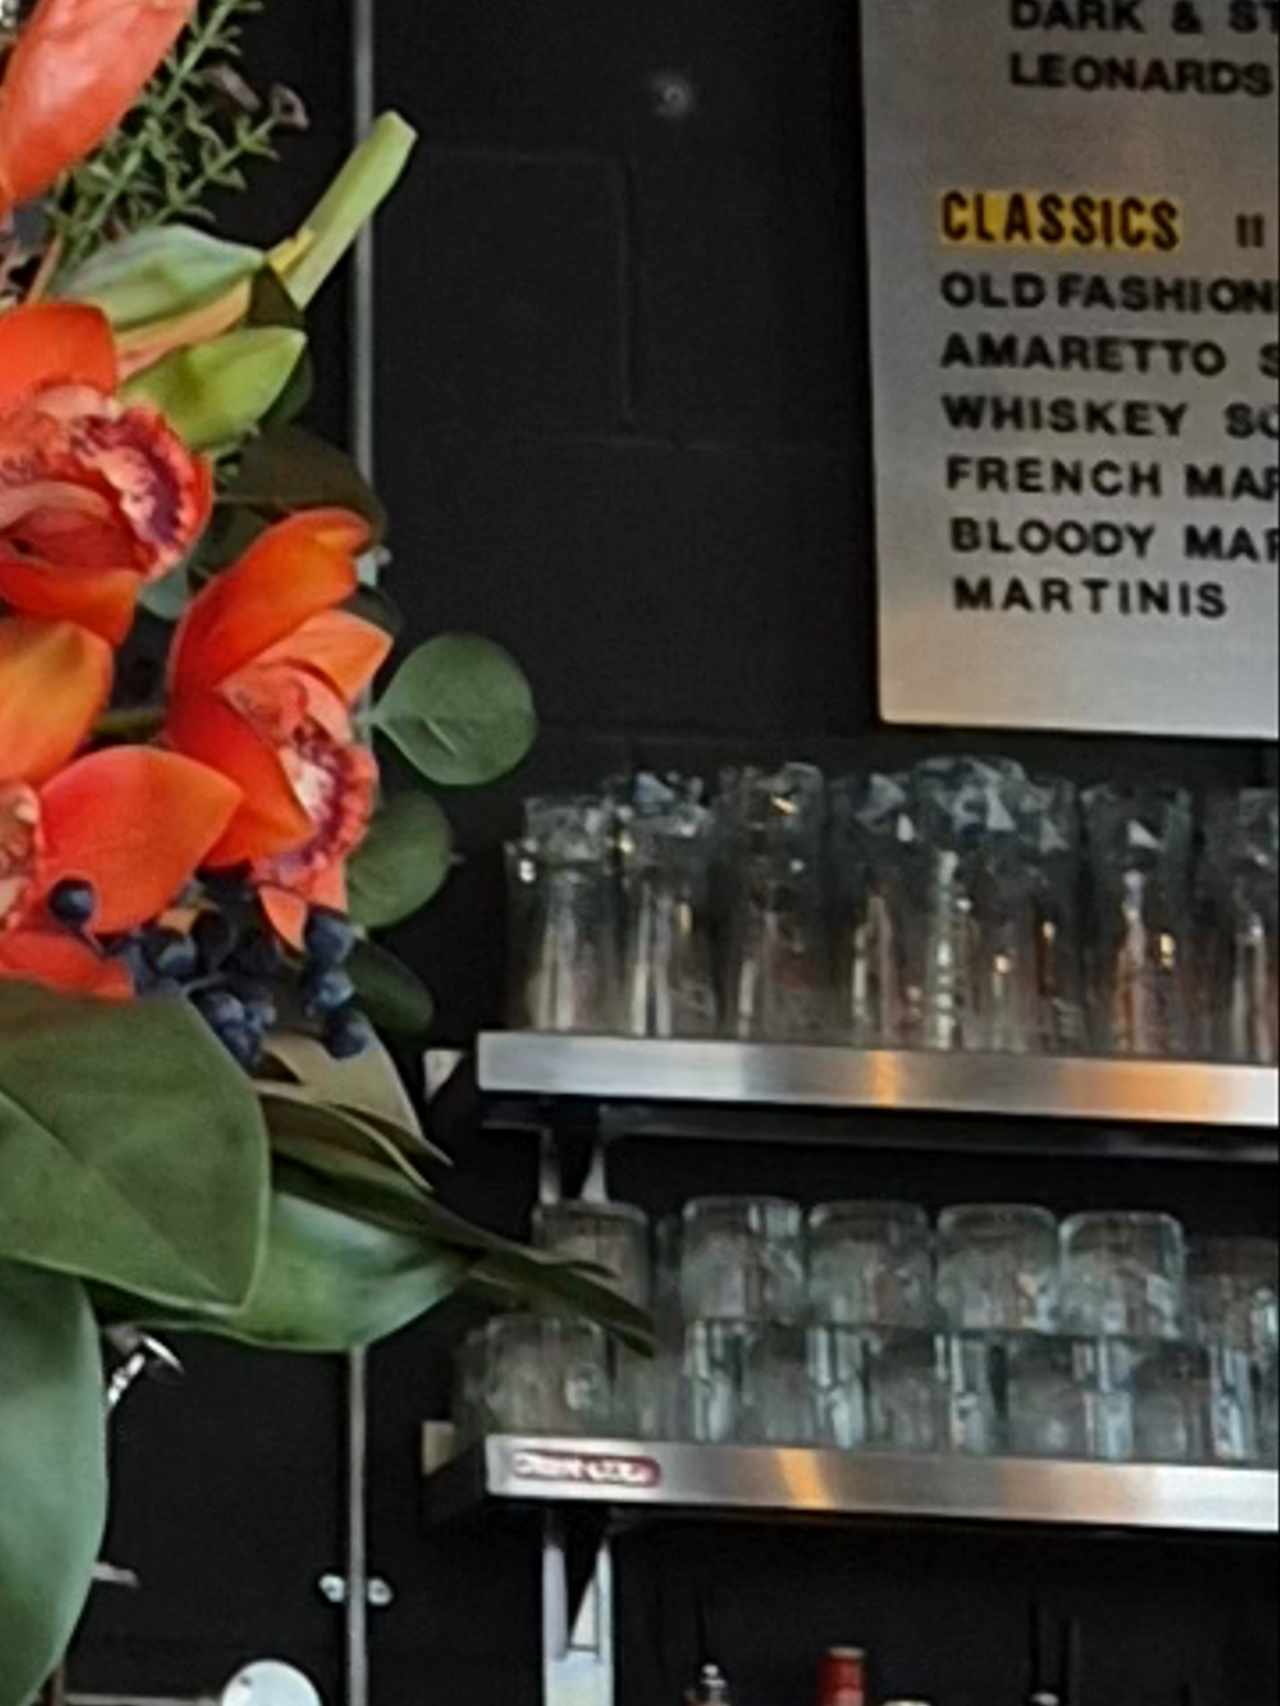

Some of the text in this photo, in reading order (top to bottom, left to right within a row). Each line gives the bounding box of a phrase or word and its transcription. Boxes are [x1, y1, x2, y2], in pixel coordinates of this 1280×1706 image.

[1009, 52, 1275, 99] LEONARDS
[941, 190, 1180, 250] CLASSICS
[940, 272, 1046, 309] OLD
[940, 333, 1227, 377] AMARETTO
[941, 394, 1188, 437] WHISKEY
[946, 455, 1163, 498] FRENCH
[950, 517, 1156, 558] BLOODY
[953, 576, 1227, 619] MARTINIS
